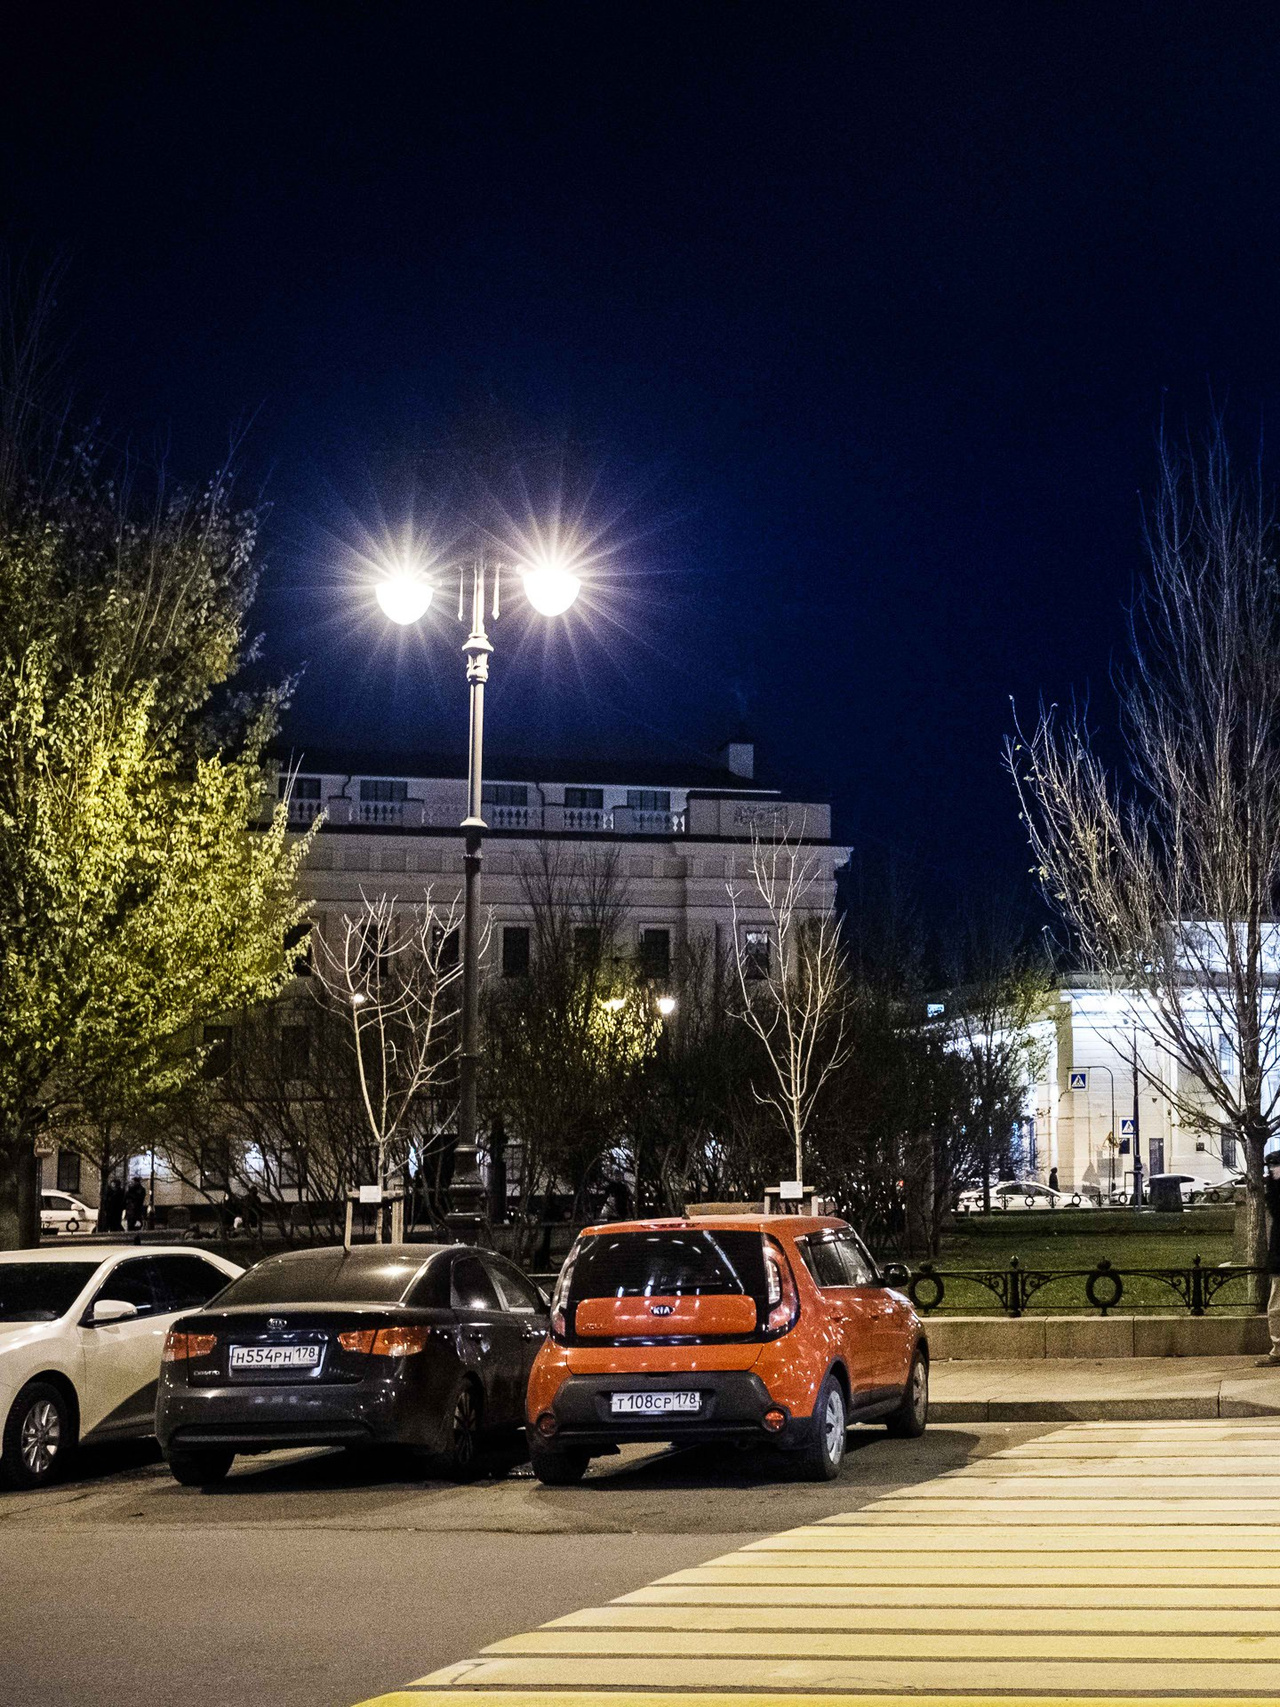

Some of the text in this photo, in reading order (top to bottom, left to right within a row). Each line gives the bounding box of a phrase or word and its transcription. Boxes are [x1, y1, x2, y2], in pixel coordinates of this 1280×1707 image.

[652, 1306, 671, 1314] KIA
[236, 1347, 316, 1363] Н554РН 178
[617, 1393, 696, 1409] Т108СР 178
